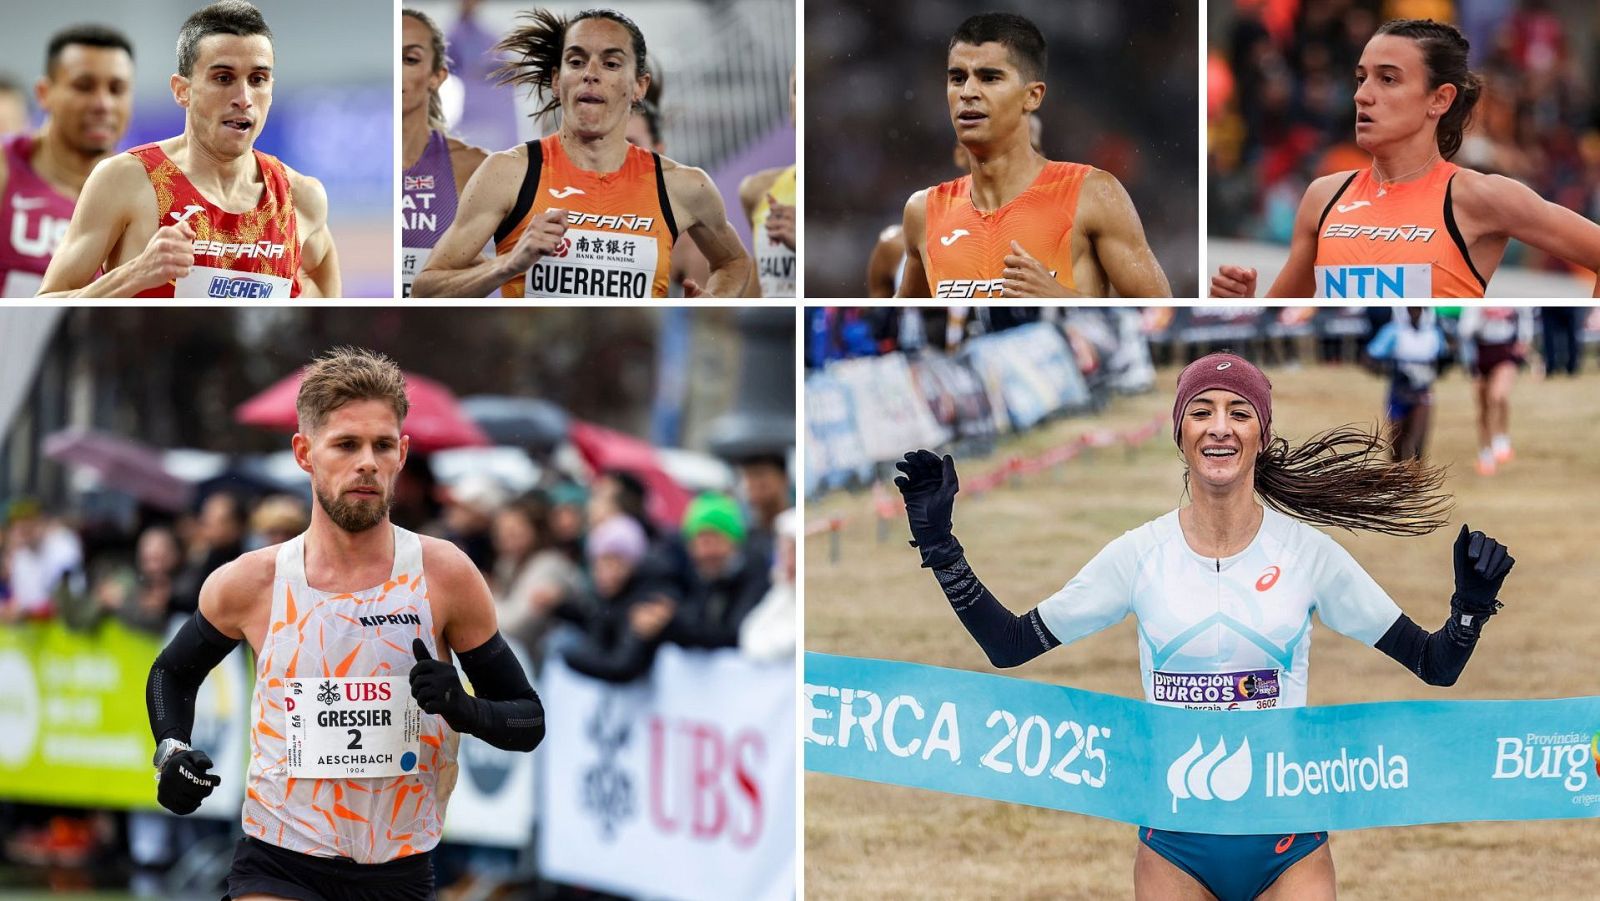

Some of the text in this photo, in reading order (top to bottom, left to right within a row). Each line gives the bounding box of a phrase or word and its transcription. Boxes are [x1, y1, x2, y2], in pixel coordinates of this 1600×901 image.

[545, 208, 654, 232] SPAÑA
[1323, 223, 1437, 243] ESPAÑA
[192, 240, 285, 259] ESPAÑA
[576, 236, 636, 256] 南京银行
[209, 276, 273, 298] HI-CHEW
[531, 263, 647, 298] GUERRERO
[1325, 267, 1404, 298] NTN
[359, 614, 421, 627] KIPRUN
[1154, 674, 1234, 687] DIPUTACIÓN
[344, 682, 392, 702] UBS
[1154, 686, 1235, 701] BURGOS
[1256, 699, 1277, 710] 3602
[317, 709, 392, 727] GRESSIER
[347, 729, 363, 750] 2
[803, 683, 1111, 788] ERCA 2025
[1526, 731, 1579, 745] Provincia
[317, 754, 393, 765] AESCHBACH
[178, 764, 212, 787] KIPRUN
[1266, 745, 1408, 797] Iberdrola
[648, 716, 766, 848] UBS
